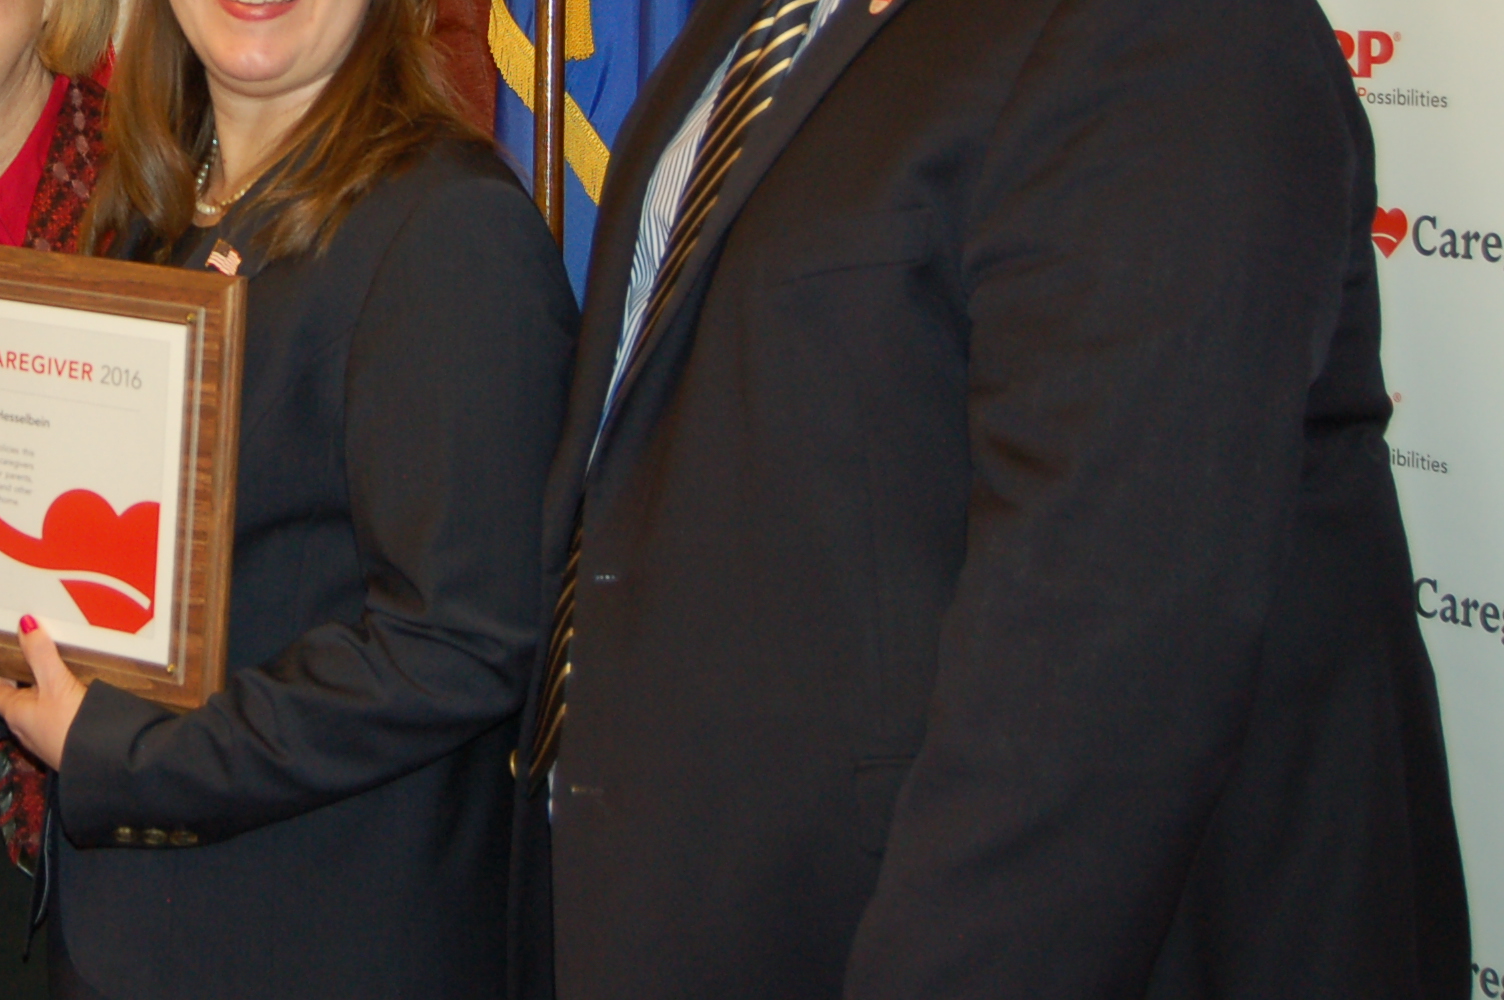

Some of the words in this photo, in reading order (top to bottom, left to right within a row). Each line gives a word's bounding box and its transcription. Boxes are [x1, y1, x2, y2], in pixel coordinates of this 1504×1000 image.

[100, 364, 142, 390] 2016
[1391, 449, 1448, 474] ibilities
[1414, 577, 1504, 646] Care
